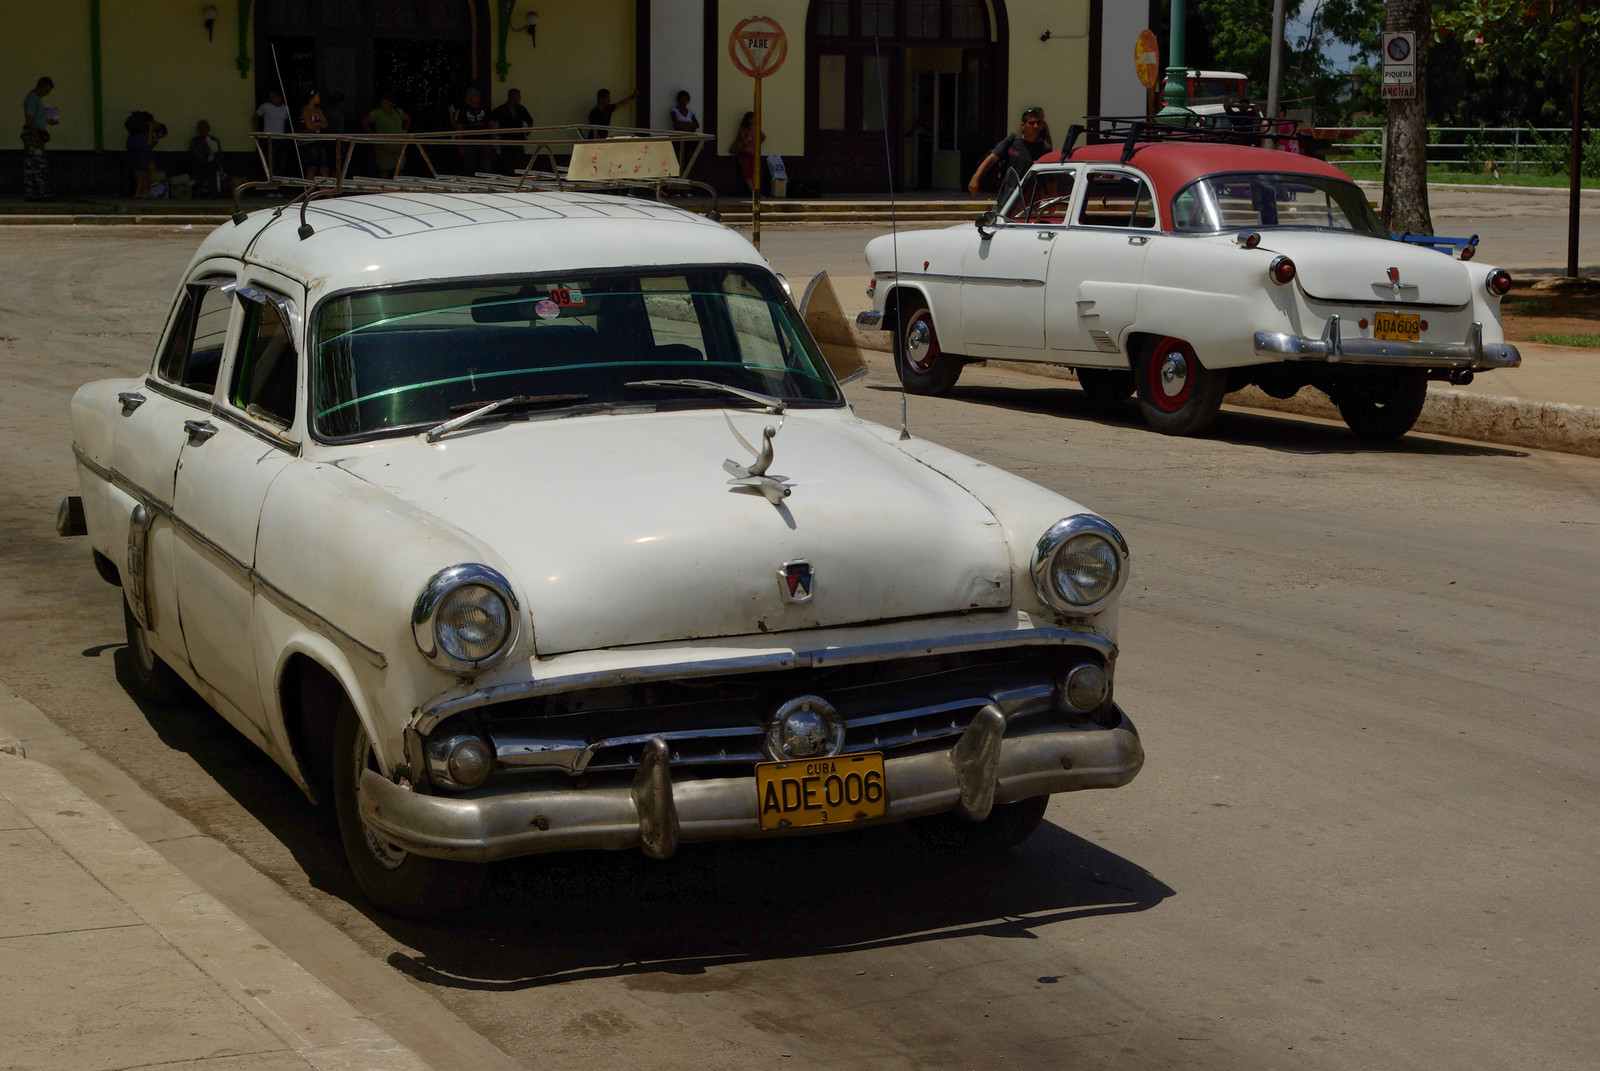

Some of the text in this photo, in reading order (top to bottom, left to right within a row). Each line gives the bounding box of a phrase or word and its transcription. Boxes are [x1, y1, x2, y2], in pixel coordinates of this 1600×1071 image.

[748, 39, 769, 49] PARE
[1385, 71, 1413, 79] PIQUERA
[551, 290, 570, 305] 09
[1376, 319, 1419, 334] ADA609
[806, 762, 837, 775] CUBA
[821, 810, 828, 822] 3
